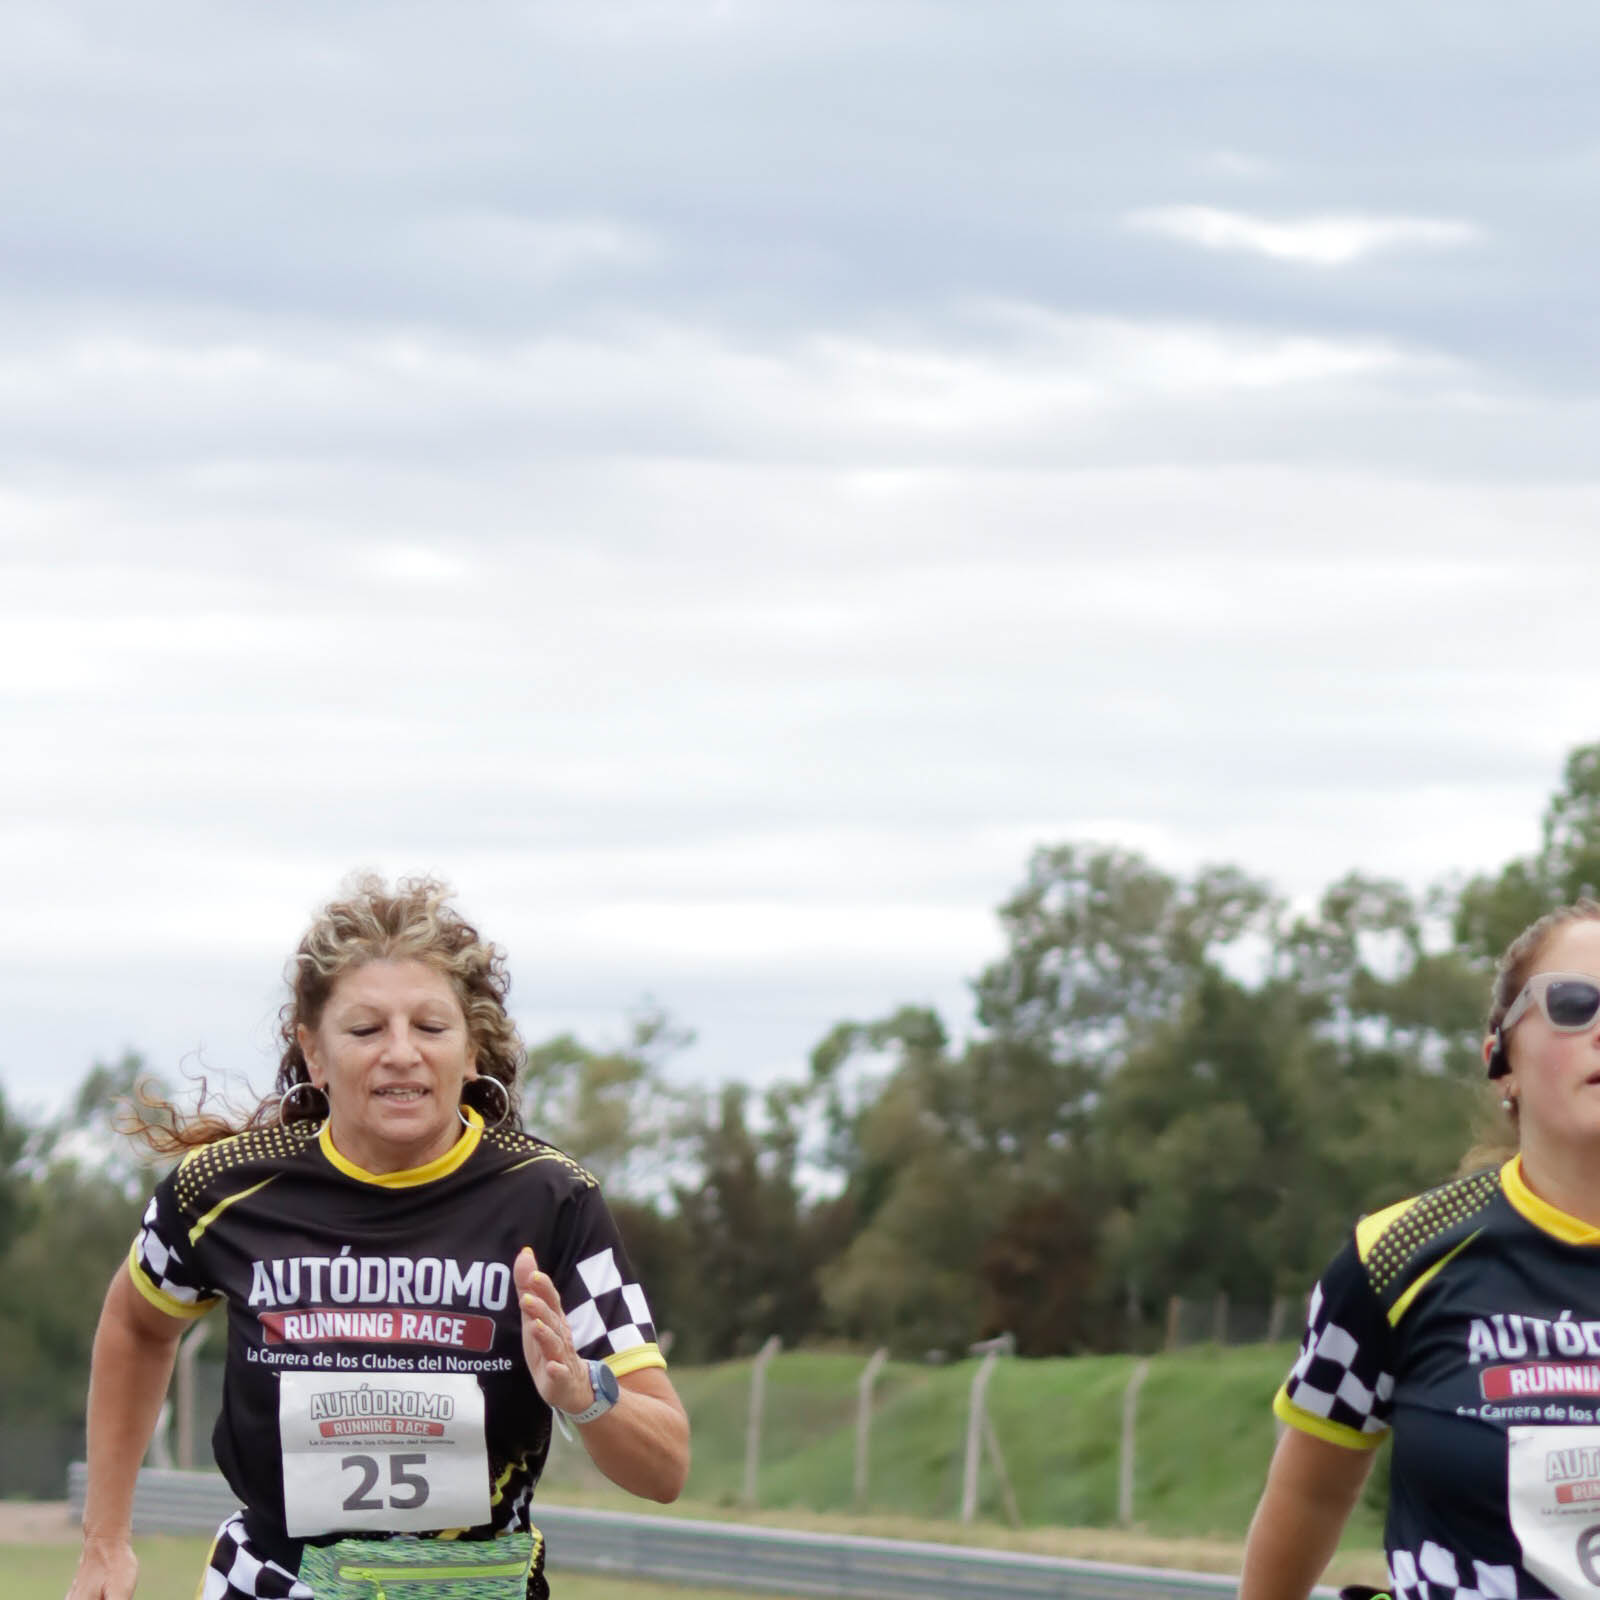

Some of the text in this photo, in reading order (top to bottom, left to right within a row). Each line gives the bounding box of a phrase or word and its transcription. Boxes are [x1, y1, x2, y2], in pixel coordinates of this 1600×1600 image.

[248, 1245, 511, 1311] AUTÓDROMO
[284, 1312, 467, 1346] RUNNING RACE
[246, 1347, 512, 1371] La Carrera de los Clubes del Noroeste
[310, 1382, 455, 1420] AUTÓDROMO
[1480, 1404, 1541, 1419] Carrera
[1544, 1404, 1567, 1420] de
[1569, 1405, 1593, 1422] los
[333, 1419, 431, 1436] RUNNING RACE
[341, 1453, 430, 1511] 25
